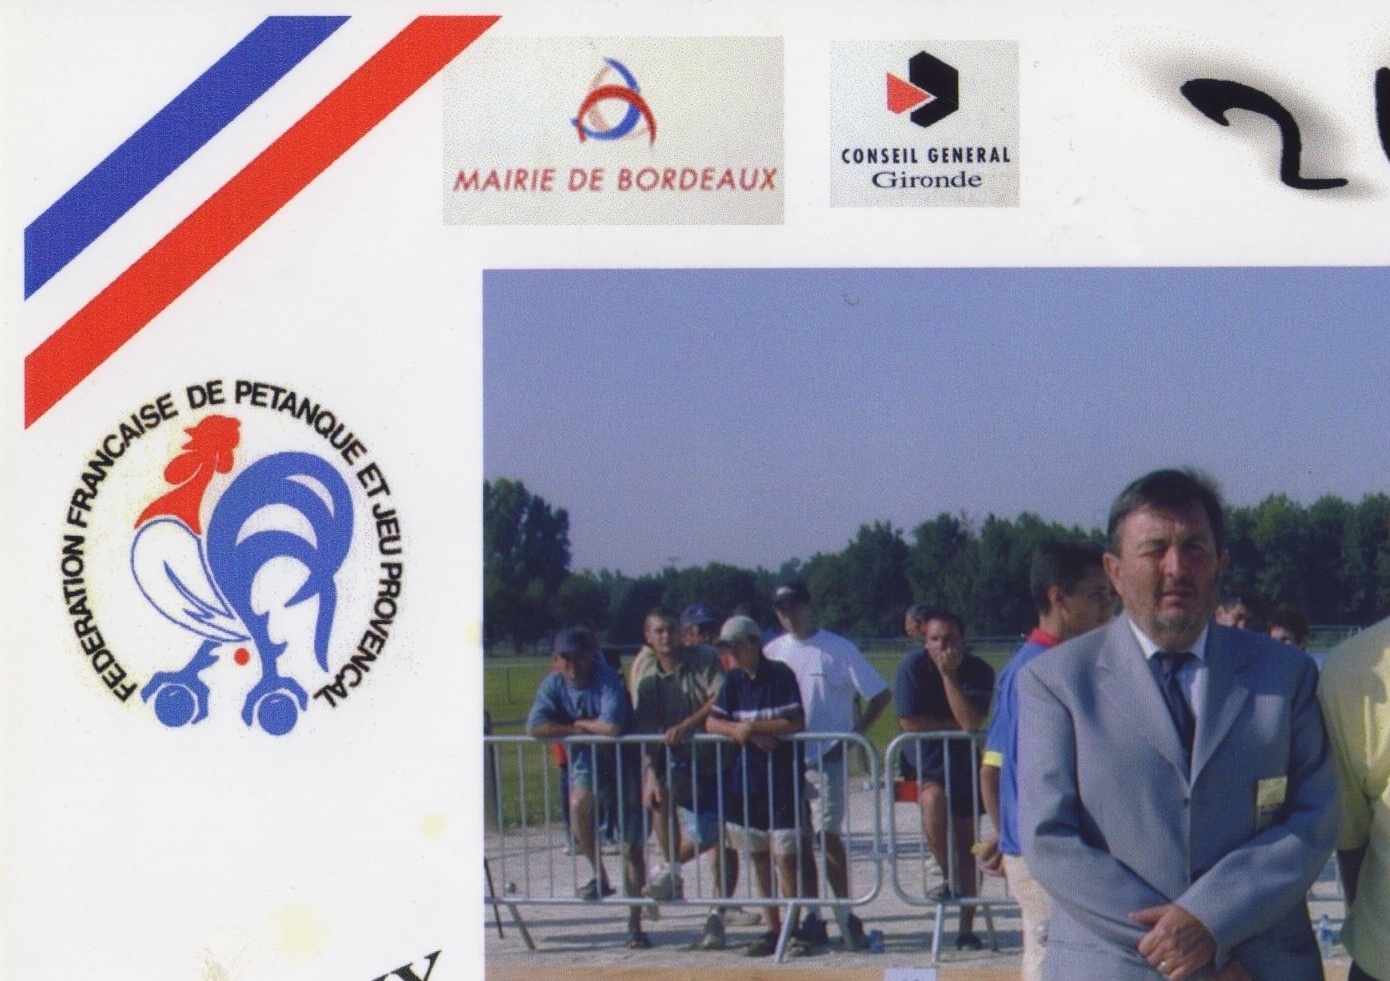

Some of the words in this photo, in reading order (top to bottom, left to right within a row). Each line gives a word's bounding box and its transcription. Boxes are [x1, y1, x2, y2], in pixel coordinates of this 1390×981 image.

[841, 147, 919, 164] CONSEIL
[927, 146, 1011, 164] GENERAL
[453, 167, 555, 192] MAIRIE
[569, 167, 604, 192] DE
[618, 167, 779, 192] BORDEAUX
[871, 170, 982, 189] Gironde
[187, 380, 225, 409] DE
[235, 380, 367, 466] PETANQUE
[67, 393, 179, 528] FRANCAISE
[357, 462, 390, 499] ET
[373, 503, 401, 555] JEU
[61, 535, 138, 703] FEDERATION
[313, 562, 403, 708] PROVENCAL
